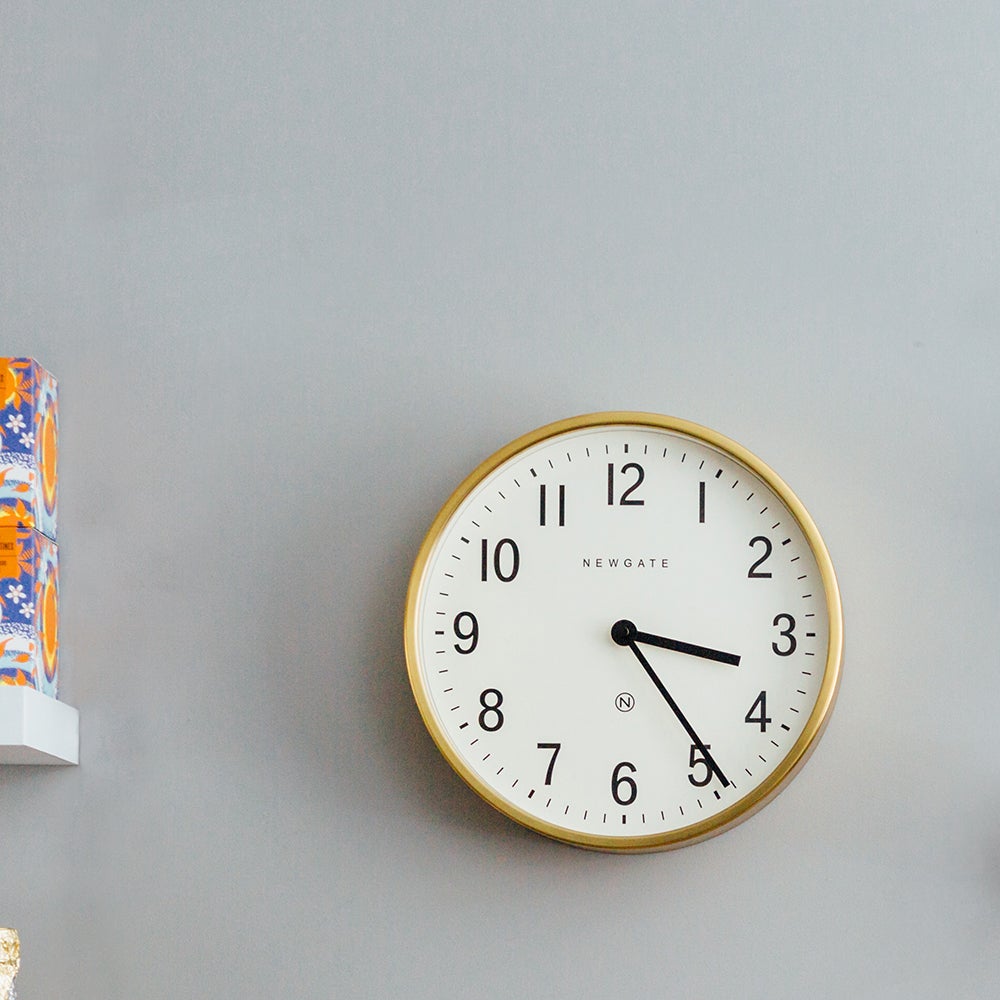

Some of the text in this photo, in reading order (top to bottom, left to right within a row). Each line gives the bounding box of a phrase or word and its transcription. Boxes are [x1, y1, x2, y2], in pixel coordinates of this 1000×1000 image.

[540, 484, 566, 526] 11
[607, 462, 645, 506] 12
[699, 482, 706, 524] 1
[481, 538, 520, 582] 10
[583, 558, 670, 568] NEWGATE
[747, 536, 773, 578] 2
[452, 611, 479, 655] 9
[771, 613, 798, 656] 3
[478, 688, 504, 732] 8
[744, 690, 772, 732] 4
[537, 742, 562, 786] 7
[610, 761, 638, 806] 6
[688, 744, 713, 788] 5
